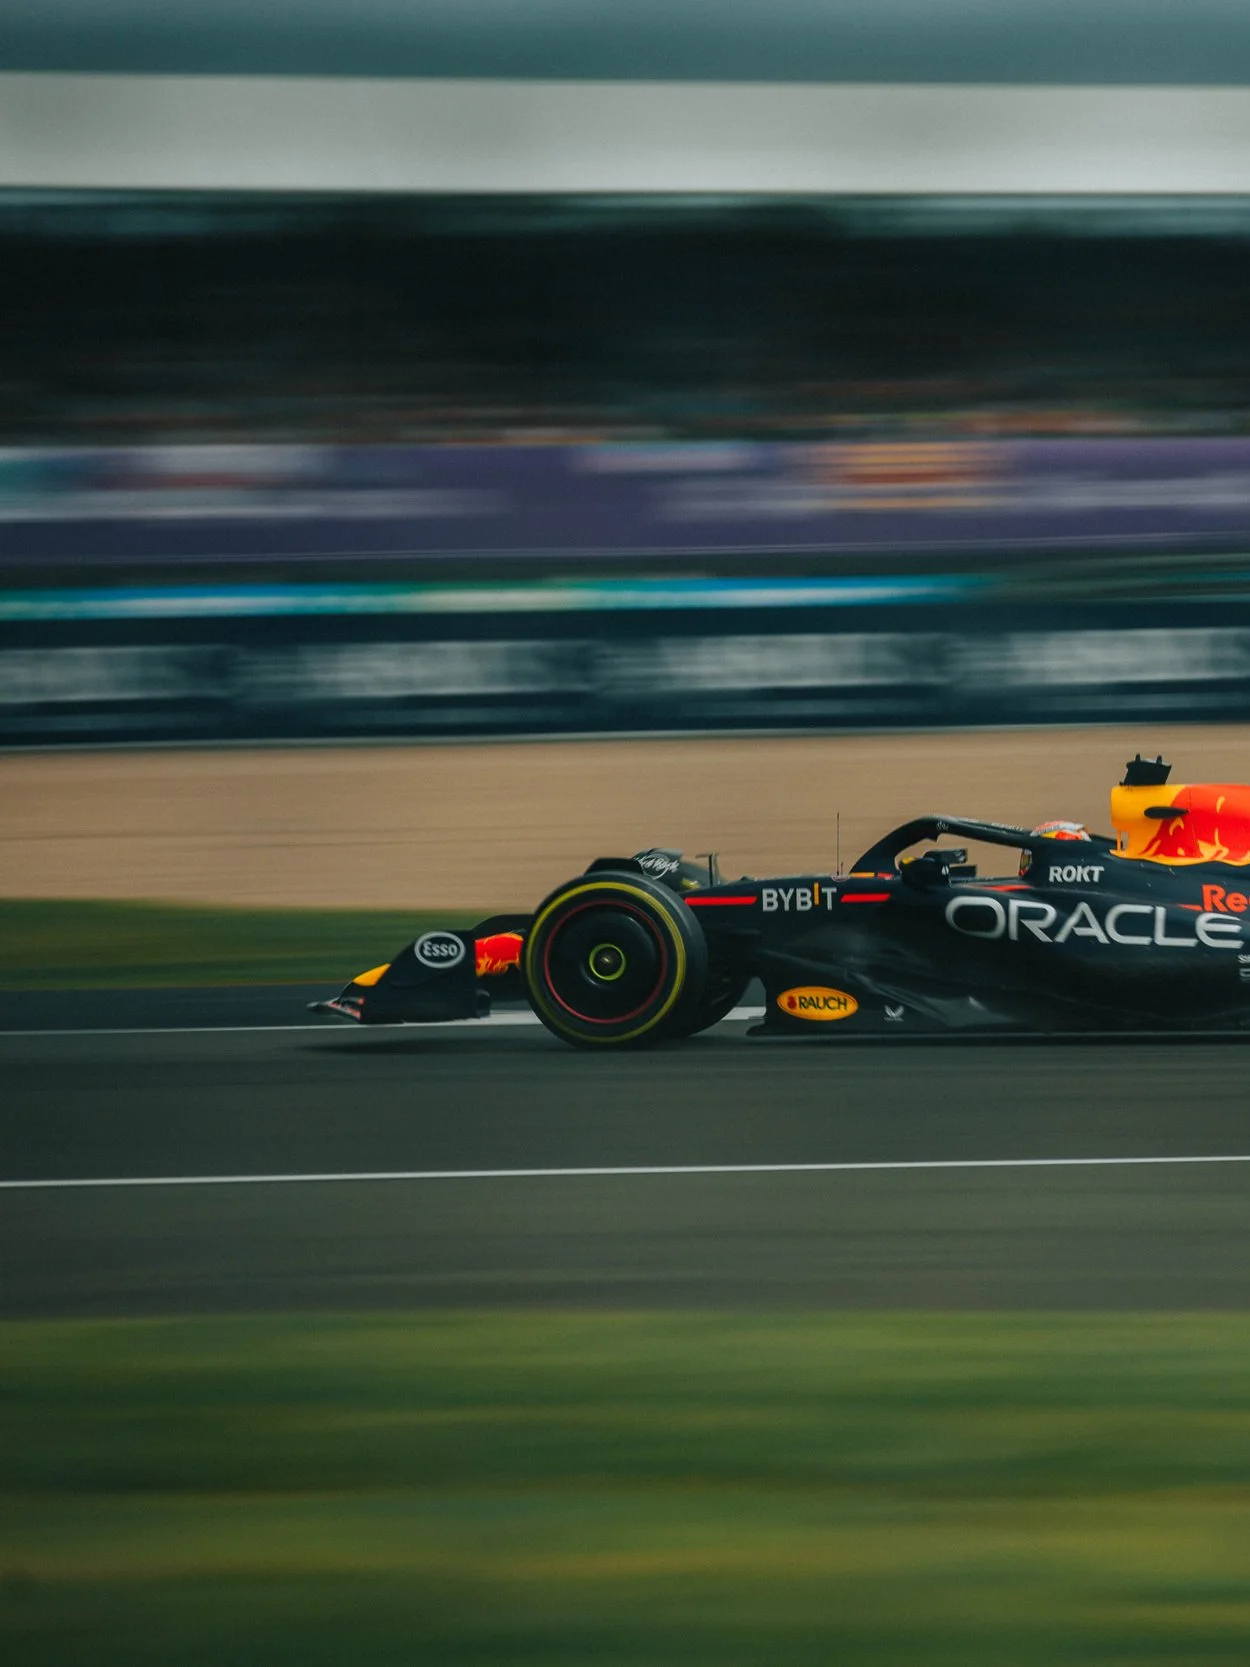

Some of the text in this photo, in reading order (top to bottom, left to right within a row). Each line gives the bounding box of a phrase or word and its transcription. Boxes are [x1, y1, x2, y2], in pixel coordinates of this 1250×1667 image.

[1049, 865, 1105, 883] ROKT
[762, 881, 838, 912] BYBIT
[945, 896, 1244, 949] ORACLE
[798, 995, 848, 1011] RAUCH
